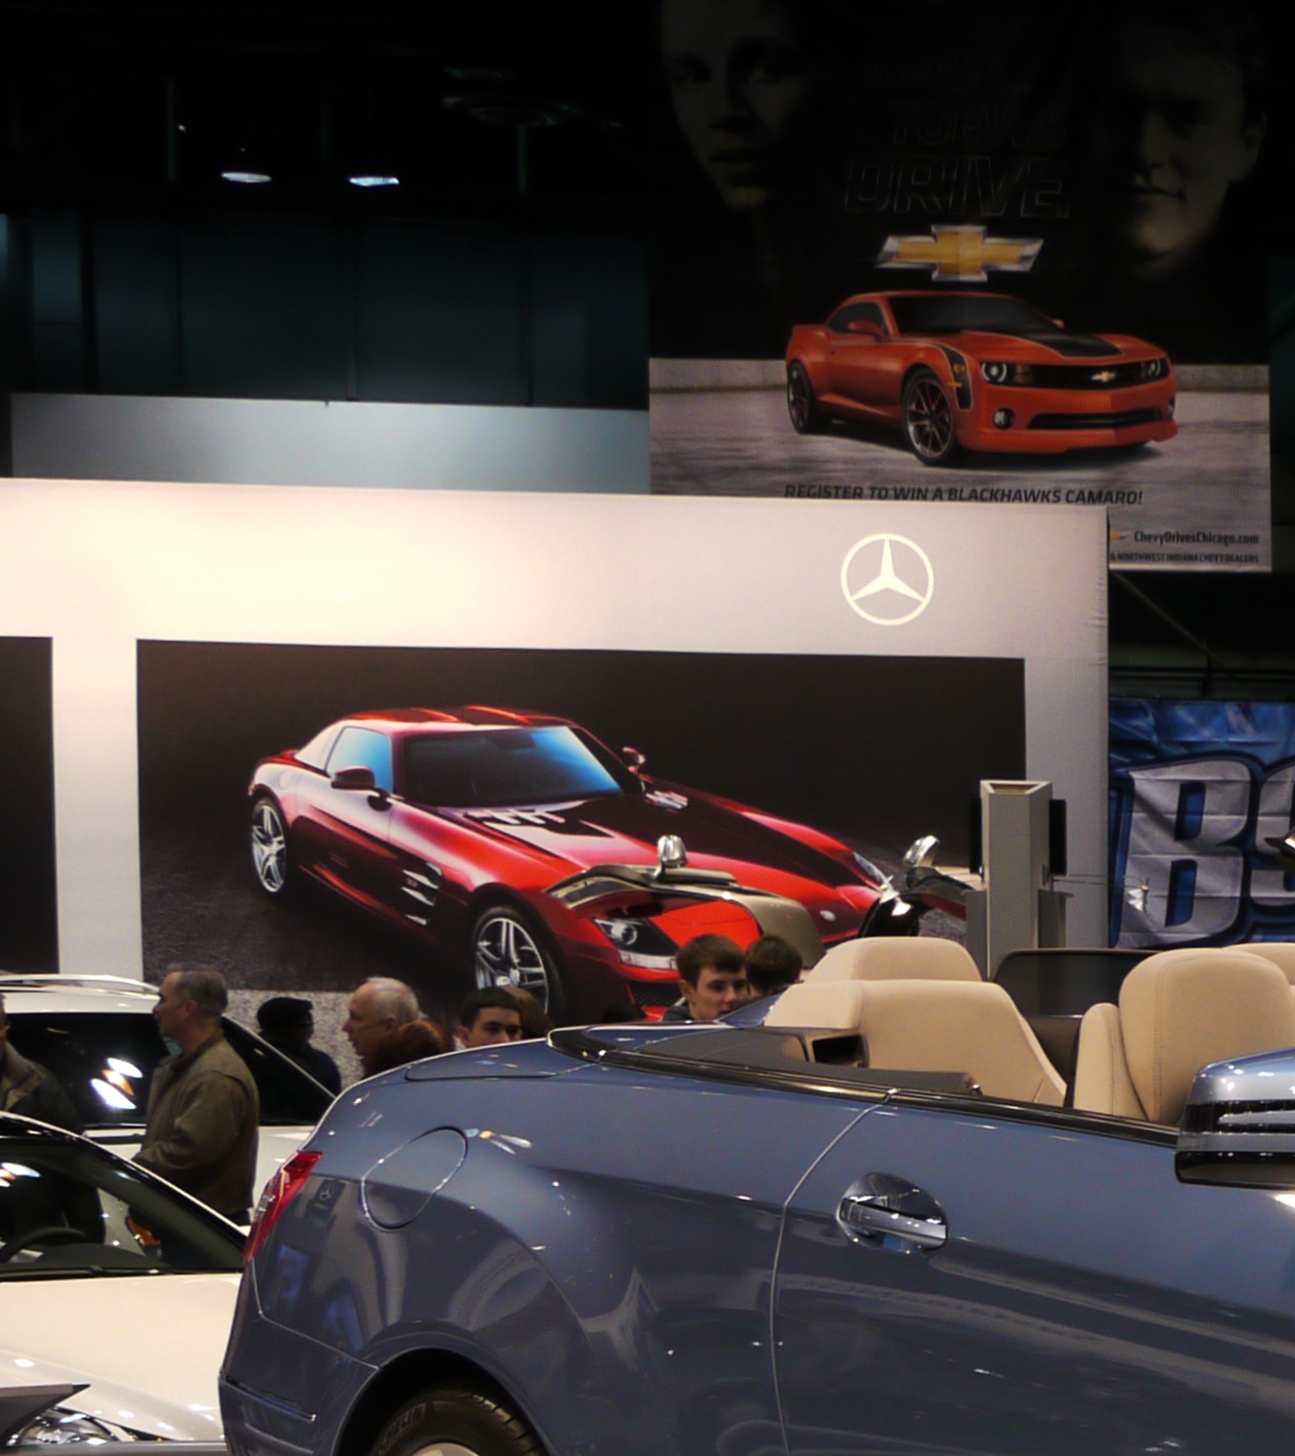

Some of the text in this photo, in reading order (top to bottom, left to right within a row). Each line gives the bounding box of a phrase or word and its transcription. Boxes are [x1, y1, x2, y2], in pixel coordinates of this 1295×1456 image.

[784, 484, 1143, 505] REGISTER TO WIN A BLACKHAWKS CAMARO!
[1134, 531, 1259, 547] ChevyDrivesChicago.com
